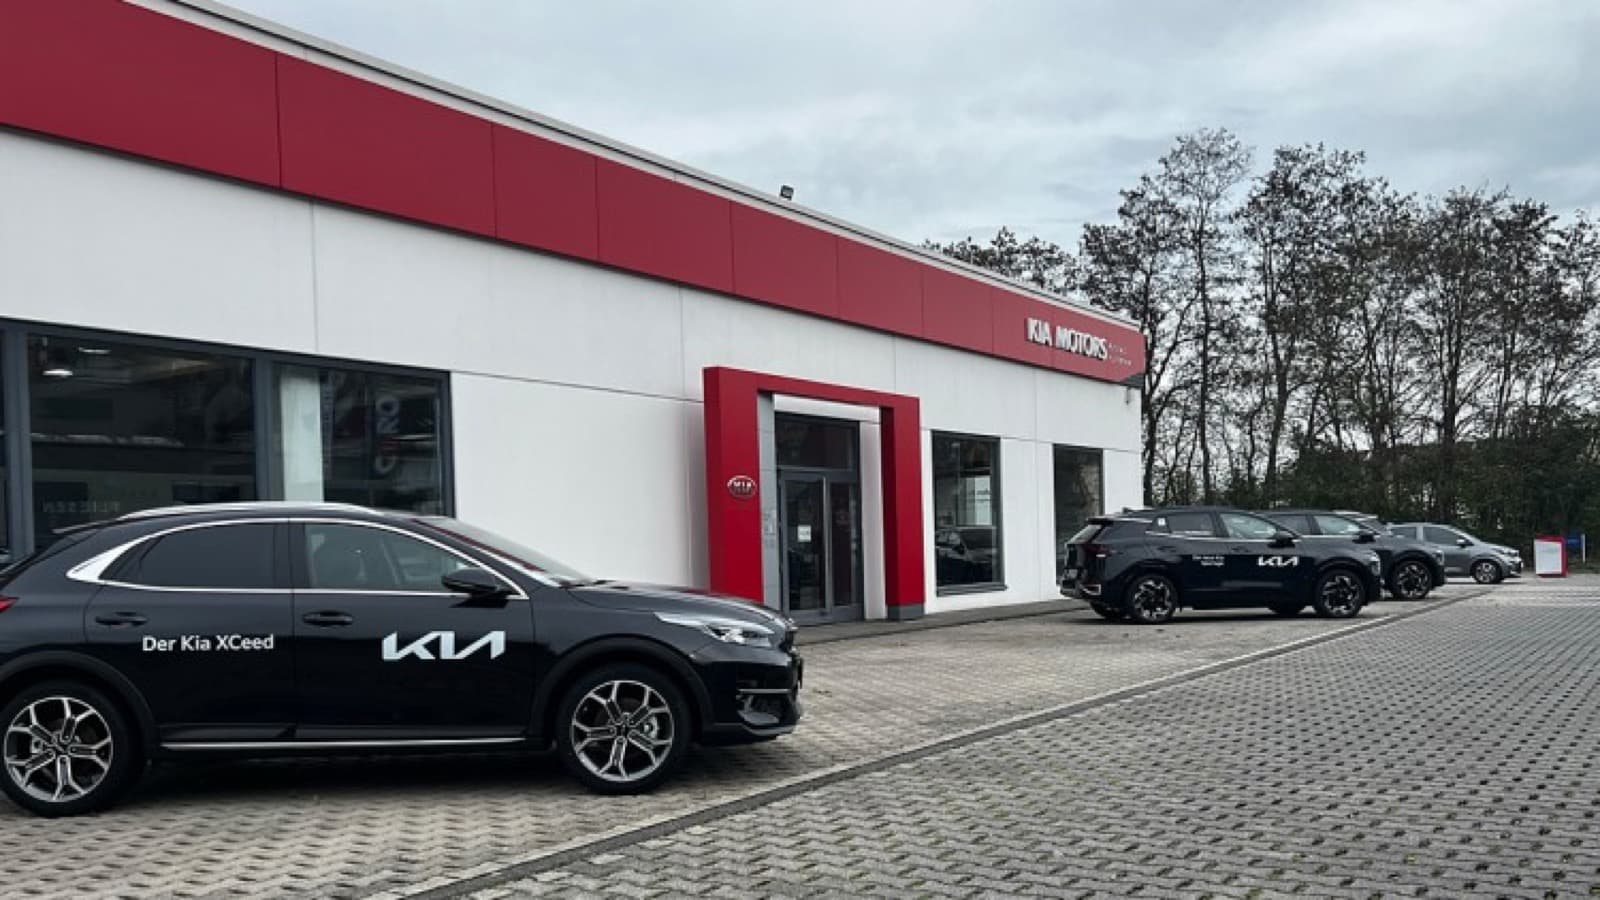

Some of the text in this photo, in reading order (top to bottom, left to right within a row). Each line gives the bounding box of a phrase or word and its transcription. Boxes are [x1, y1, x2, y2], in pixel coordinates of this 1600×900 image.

[1026, 318, 1108, 360] KIA MOTORS
[1258, 556, 1299, 567] KIA
[142, 633, 274, 651] Der Kia XCeed
[382, 630, 505, 660] KIA
